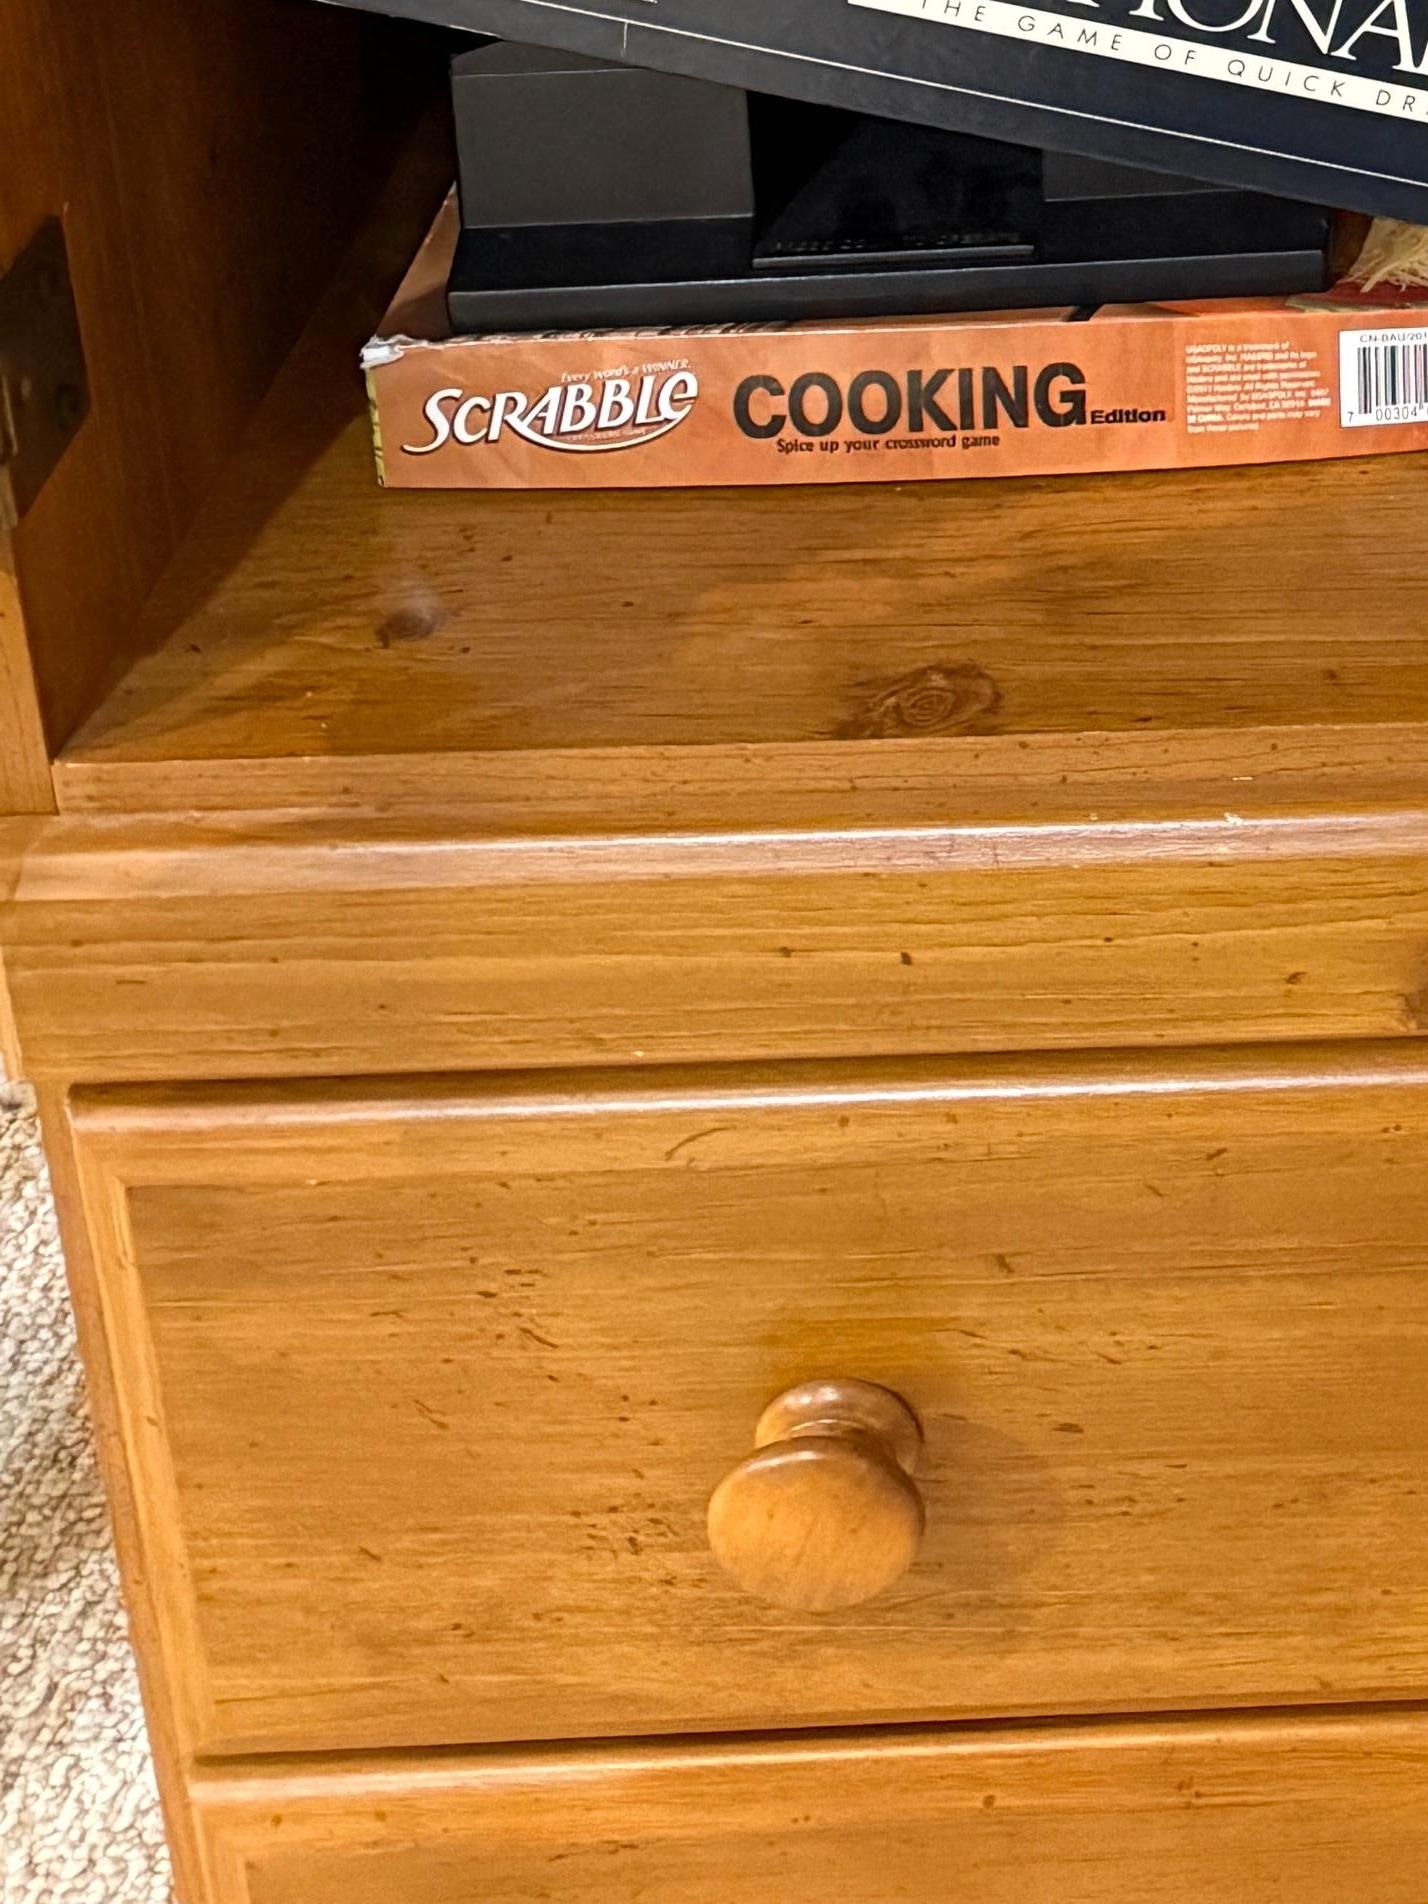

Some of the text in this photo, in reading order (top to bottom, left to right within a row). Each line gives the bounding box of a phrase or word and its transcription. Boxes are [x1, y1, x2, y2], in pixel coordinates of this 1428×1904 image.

[400, 370, 698, 456] SCRABBLE
[732, 362, 1166, 439] COOKING Edition
[777, 435, 999, 455] Spice up your crossword game
